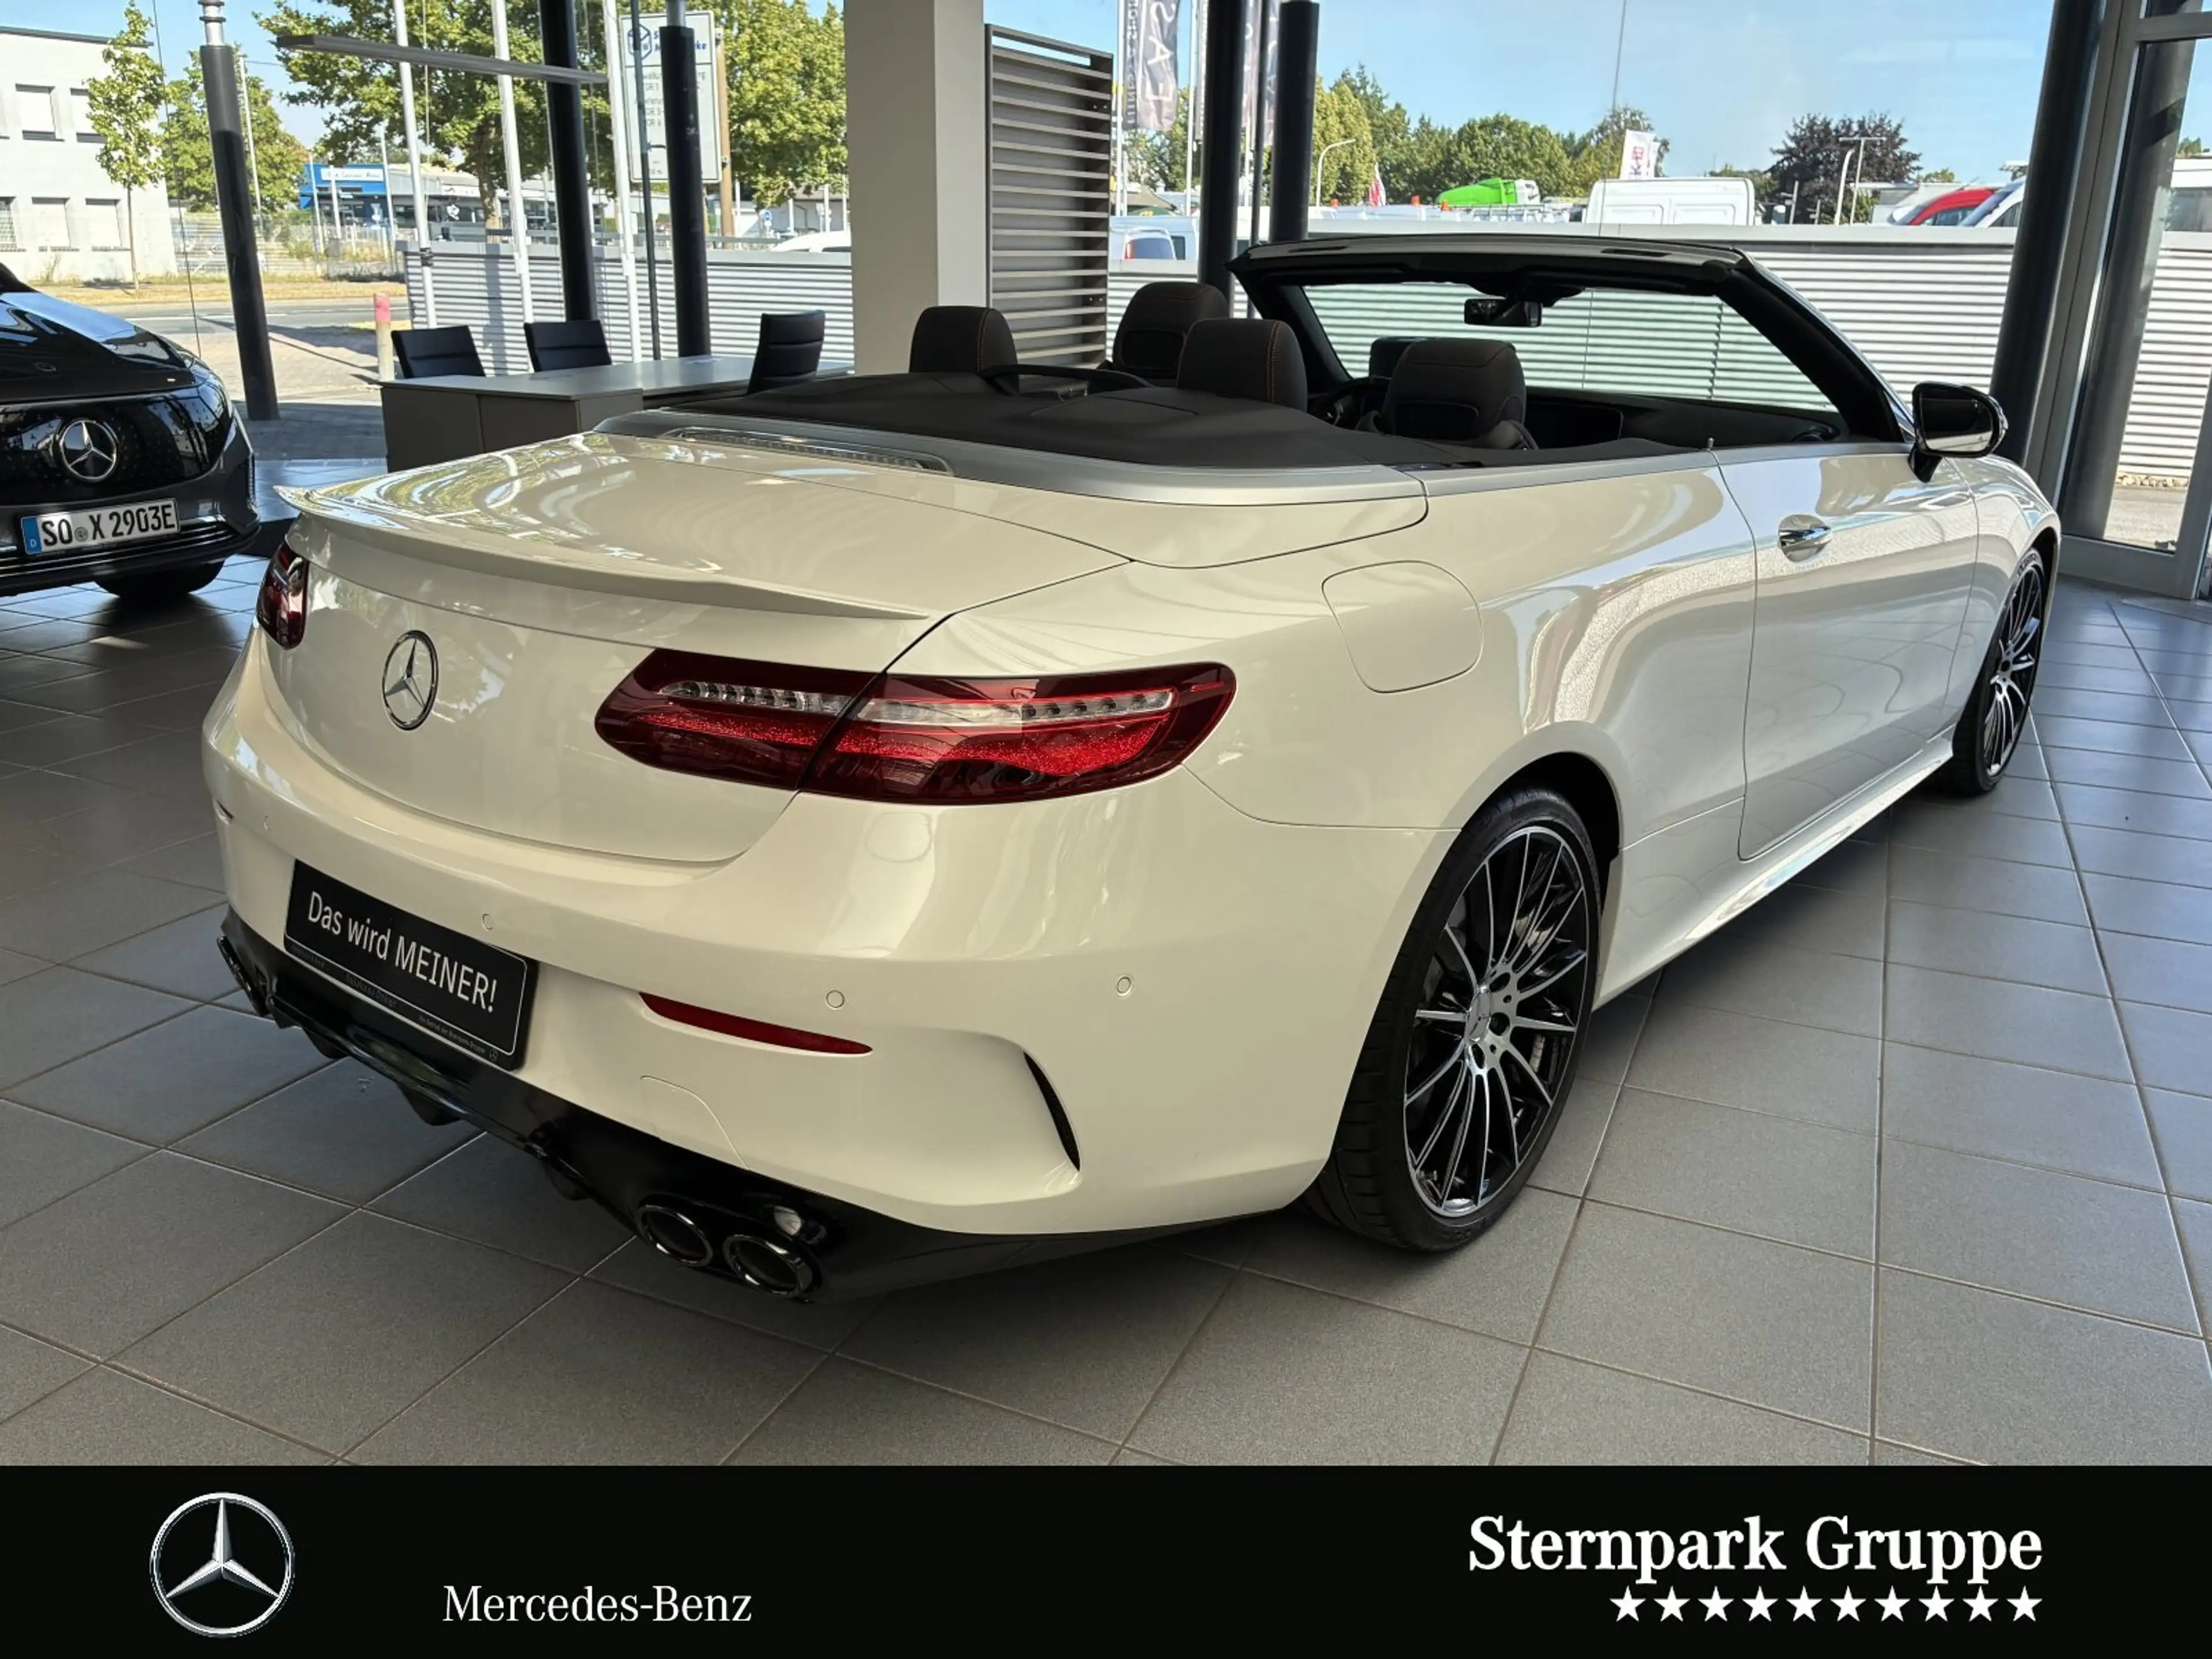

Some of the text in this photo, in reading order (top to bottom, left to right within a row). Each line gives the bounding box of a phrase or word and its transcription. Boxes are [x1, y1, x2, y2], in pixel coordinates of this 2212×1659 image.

[41, 504, 175, 547] SO X 2903E
[308, 891, 343, 935] Das
[348, 918, 391, 961] wird
[395, 935, 497, 1014] MEINER!
